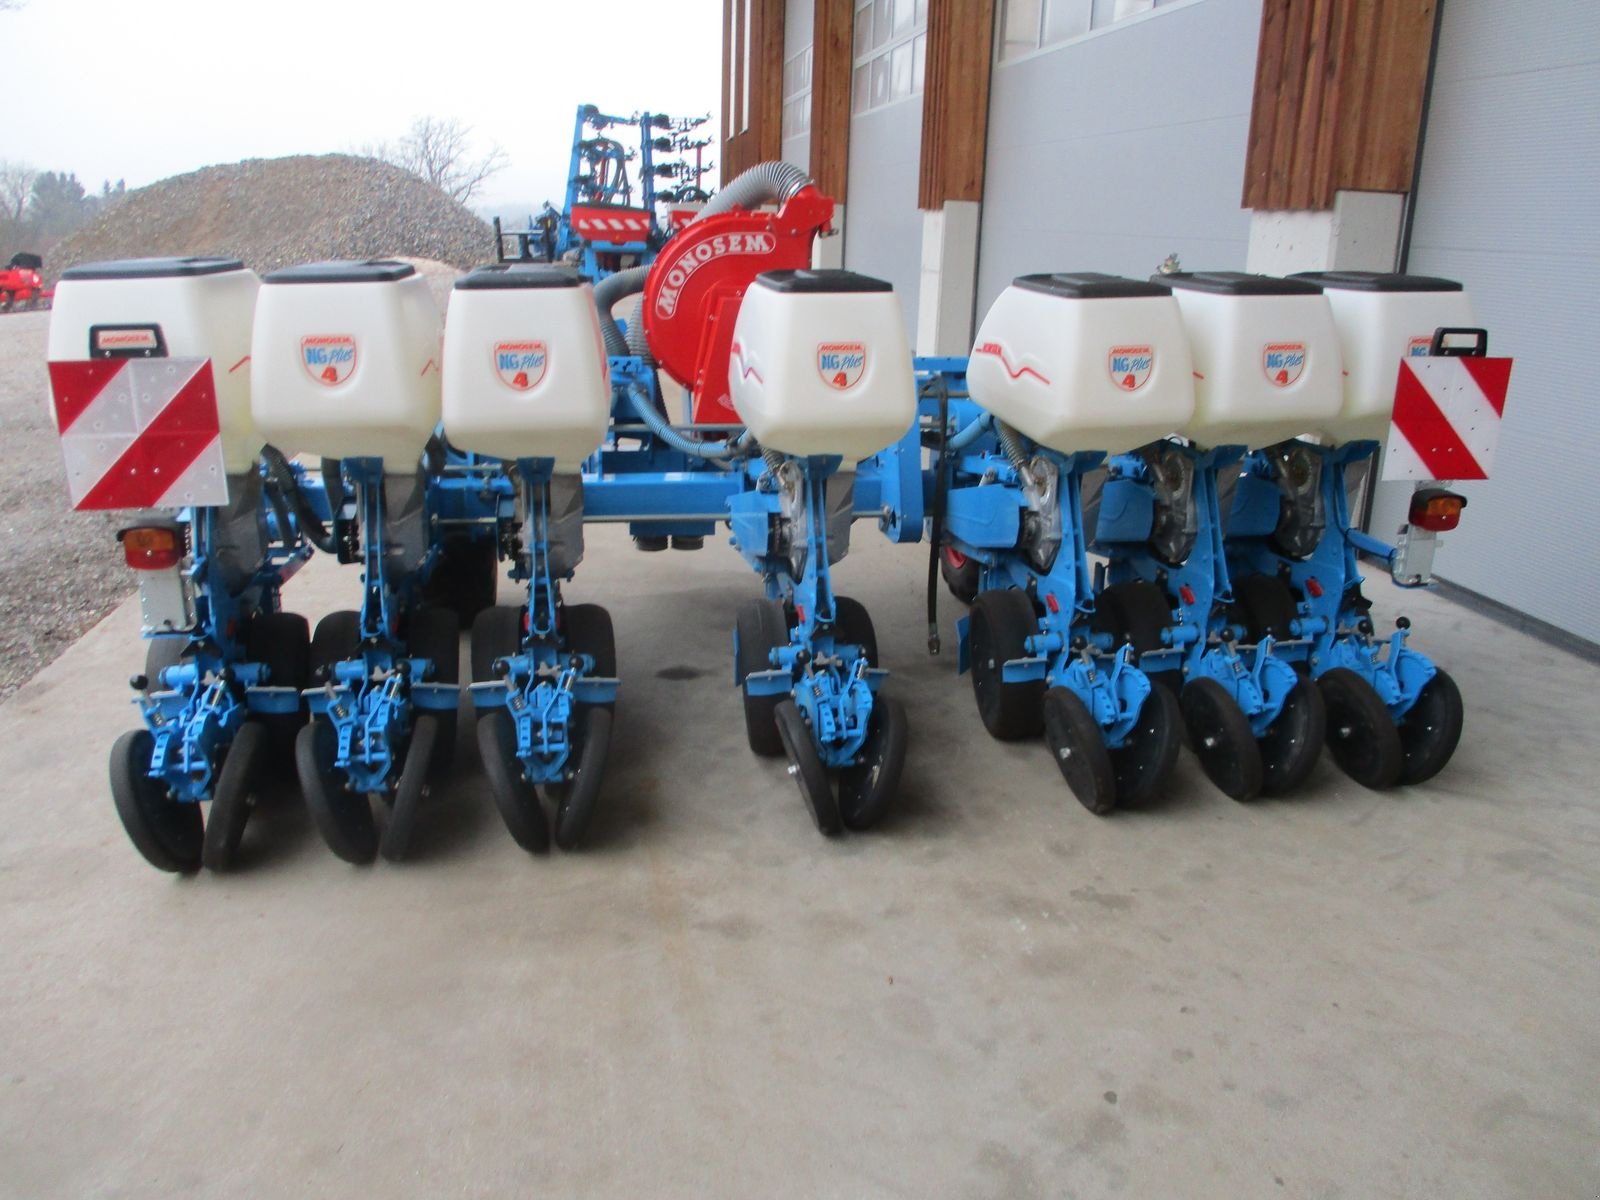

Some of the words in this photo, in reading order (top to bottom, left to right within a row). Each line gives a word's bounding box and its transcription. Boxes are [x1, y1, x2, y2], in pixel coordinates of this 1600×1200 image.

[658, 234, 770, 315] MONOSEM
[306, 347, 327, 365] NG
[499, 352, 519, 370] NG
[821, 354, 840, 370] NG
[1112, 357, 1130, 372] NG
[1266, 353, 1283, 368] NG
